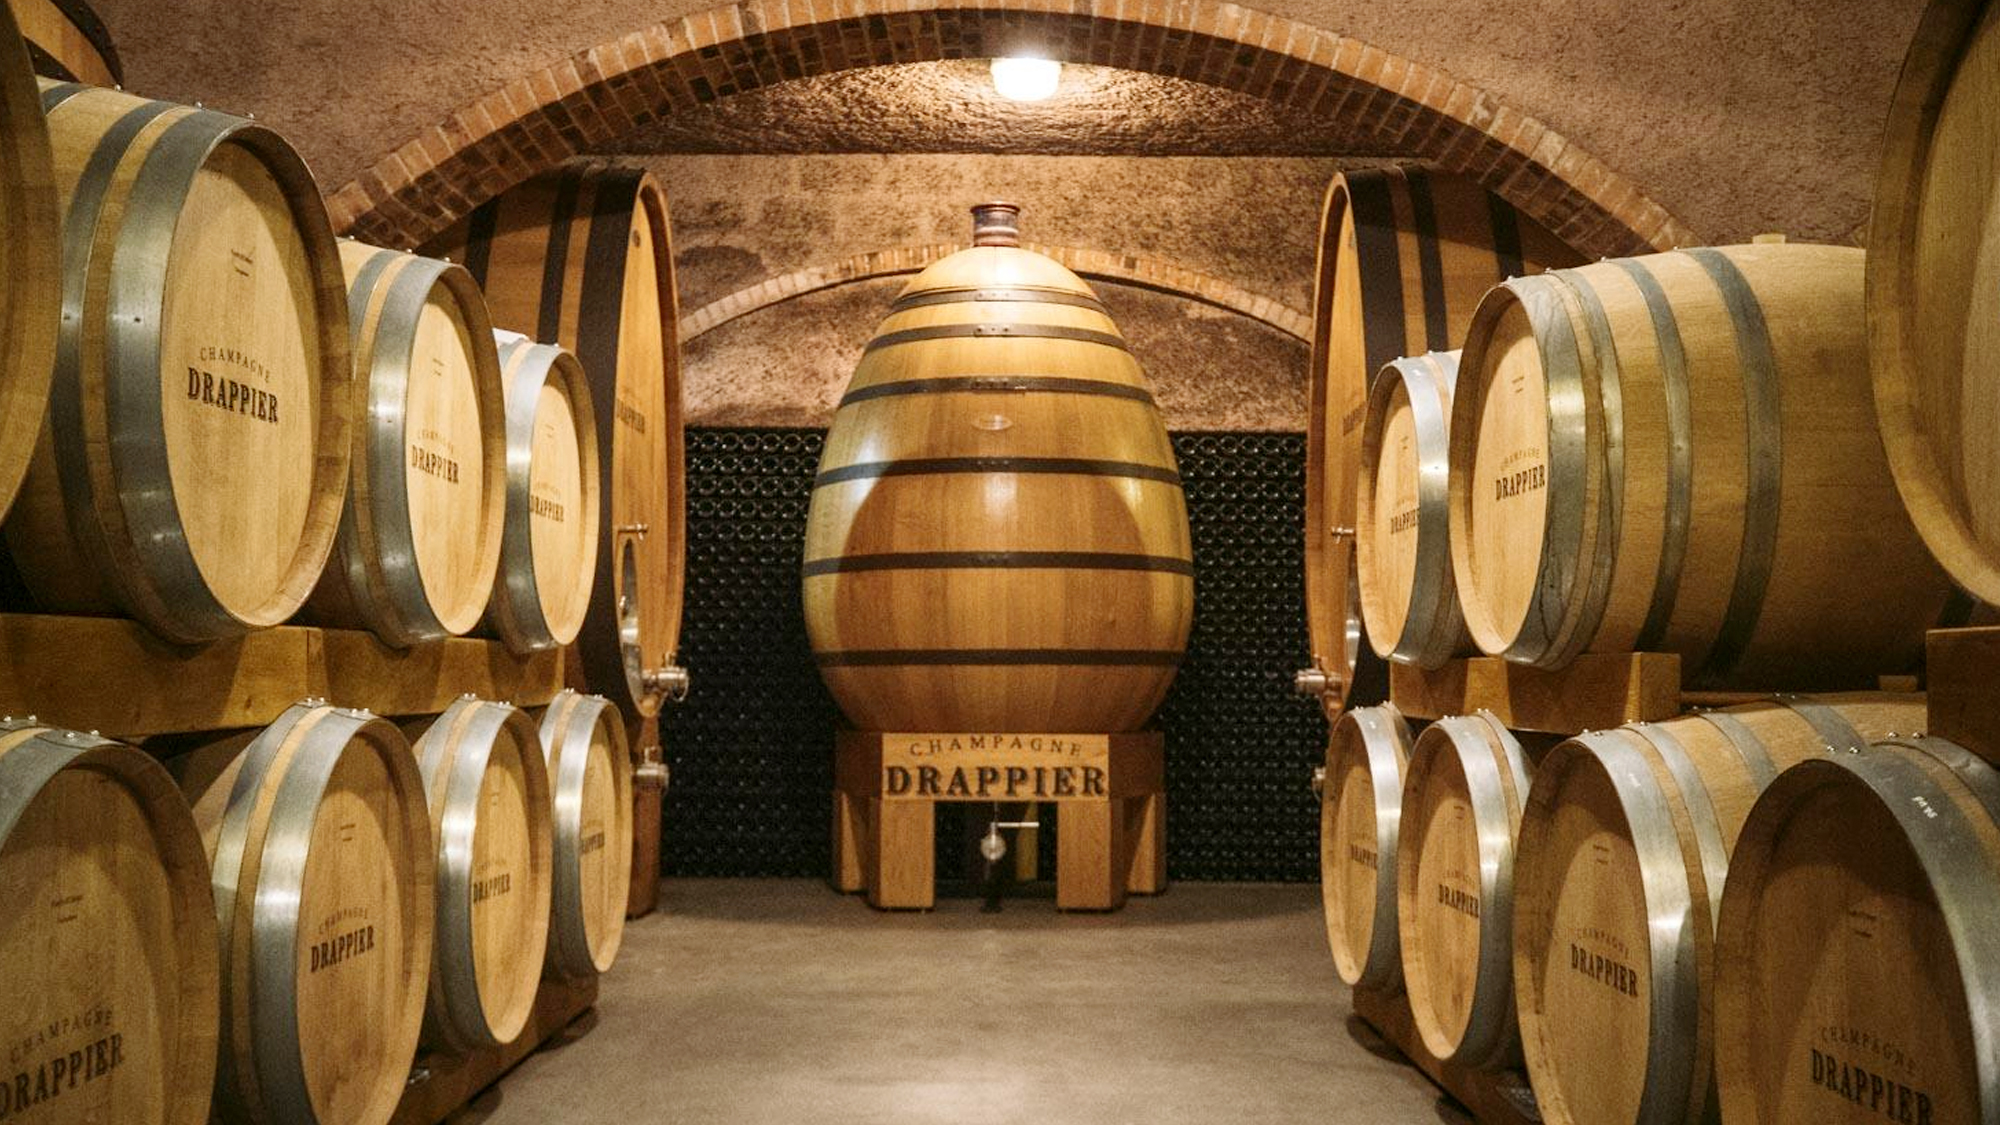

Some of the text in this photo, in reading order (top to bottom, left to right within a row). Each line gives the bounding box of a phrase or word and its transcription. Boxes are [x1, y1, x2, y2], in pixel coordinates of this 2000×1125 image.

[200, 346, 270, 384] CHAMPAGNE
[187, 366, 279, 424] DRAPPIER
[411, 444, 459, 484] DRAPPIER
[1495, 464, 1546, 501] DRAPPIER
[909, 735, 1083, 758] CHAMPAGNE
[886, 765, 1106, 798] DRAPPIER
[473, 873, 510, 904] DRAPPIER
[1438, 883, 1479, 919] DRAPPIER
[310, 925, 375, 973] DRAPPIER
[1570, 942, 1639, 998] DRAPPIER
[10, 1005, 114, 1065] CHAMPAGNE
[1811, 1047, 1933, 1125] DRAPPIER
